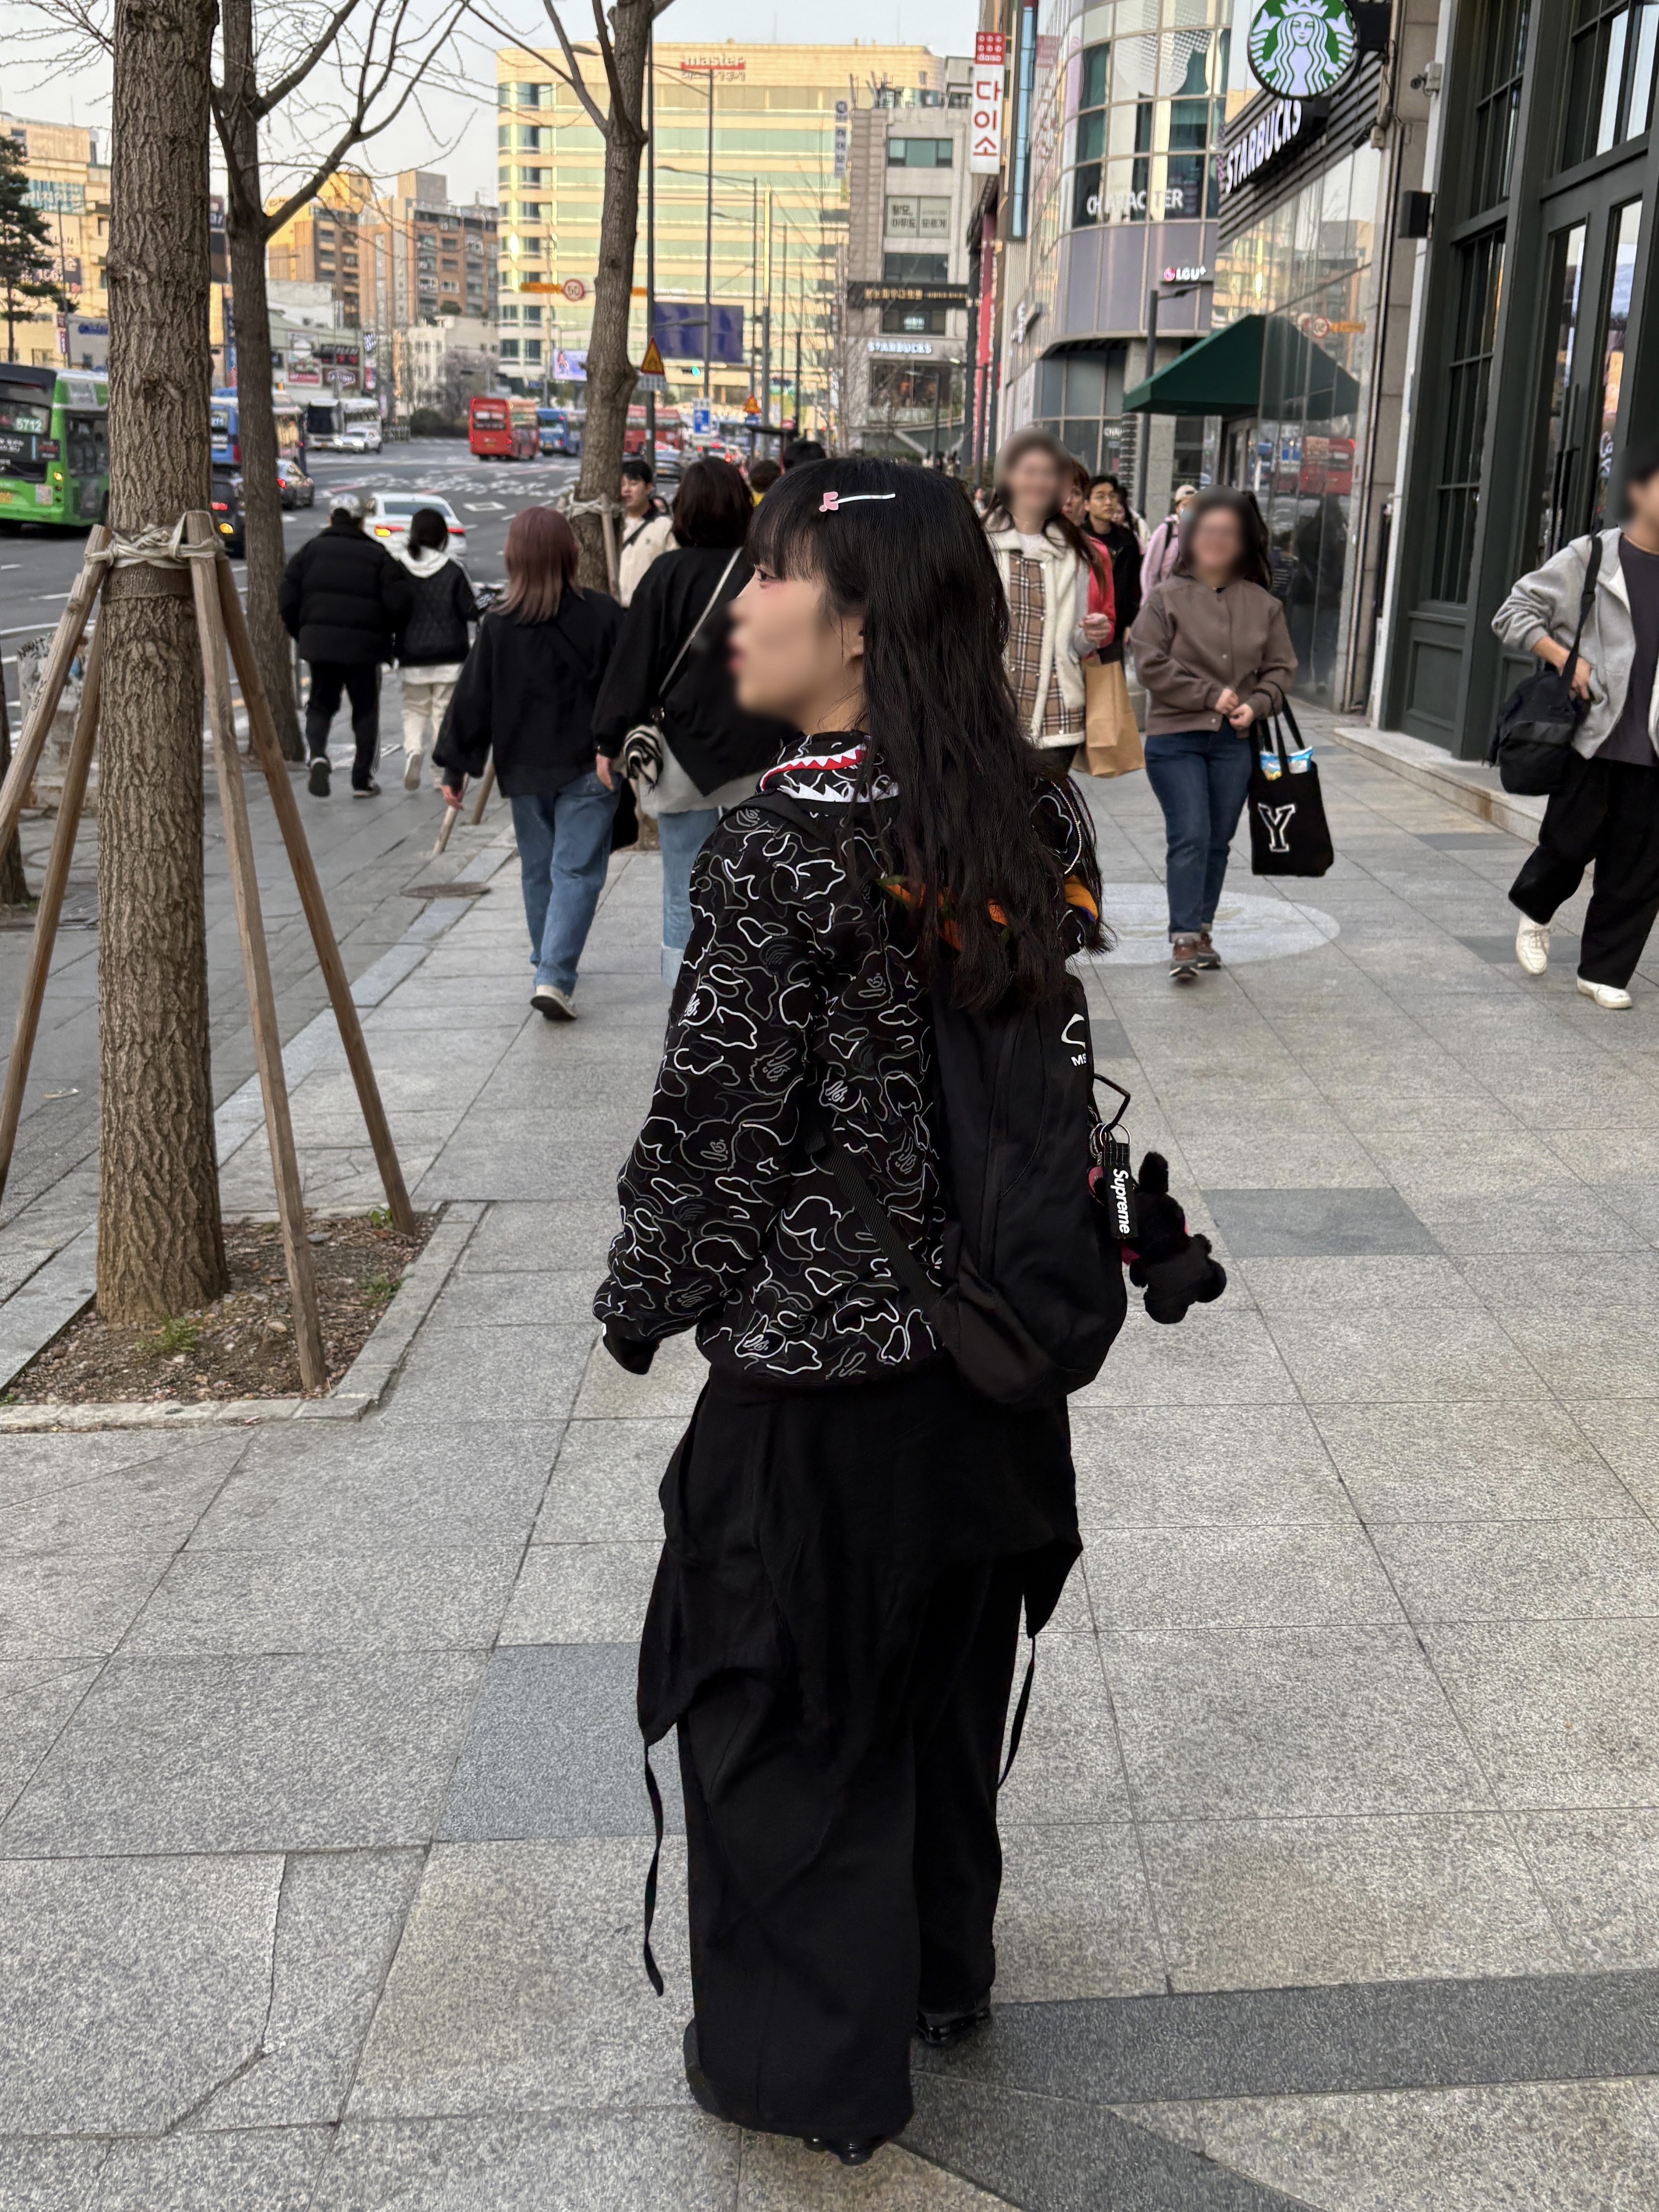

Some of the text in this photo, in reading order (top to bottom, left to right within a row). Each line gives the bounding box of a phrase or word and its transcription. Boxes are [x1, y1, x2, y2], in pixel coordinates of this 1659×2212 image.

[684, 52, 745, 66] master
[977, 53, 1001, 61] daiso
[973, 80, 1002, 157] 다이소
[1225, 99, 1302, 194] STARBUCKS
[1086, 188, 1184, 215] CHARACTER
[867, 341, 932, 354] STARBUCKS
[15, 418, 43, 434] 5712
[1257, 802, 1296, 852] Y
[1110, 1168, 1130, 1234] Supreme
